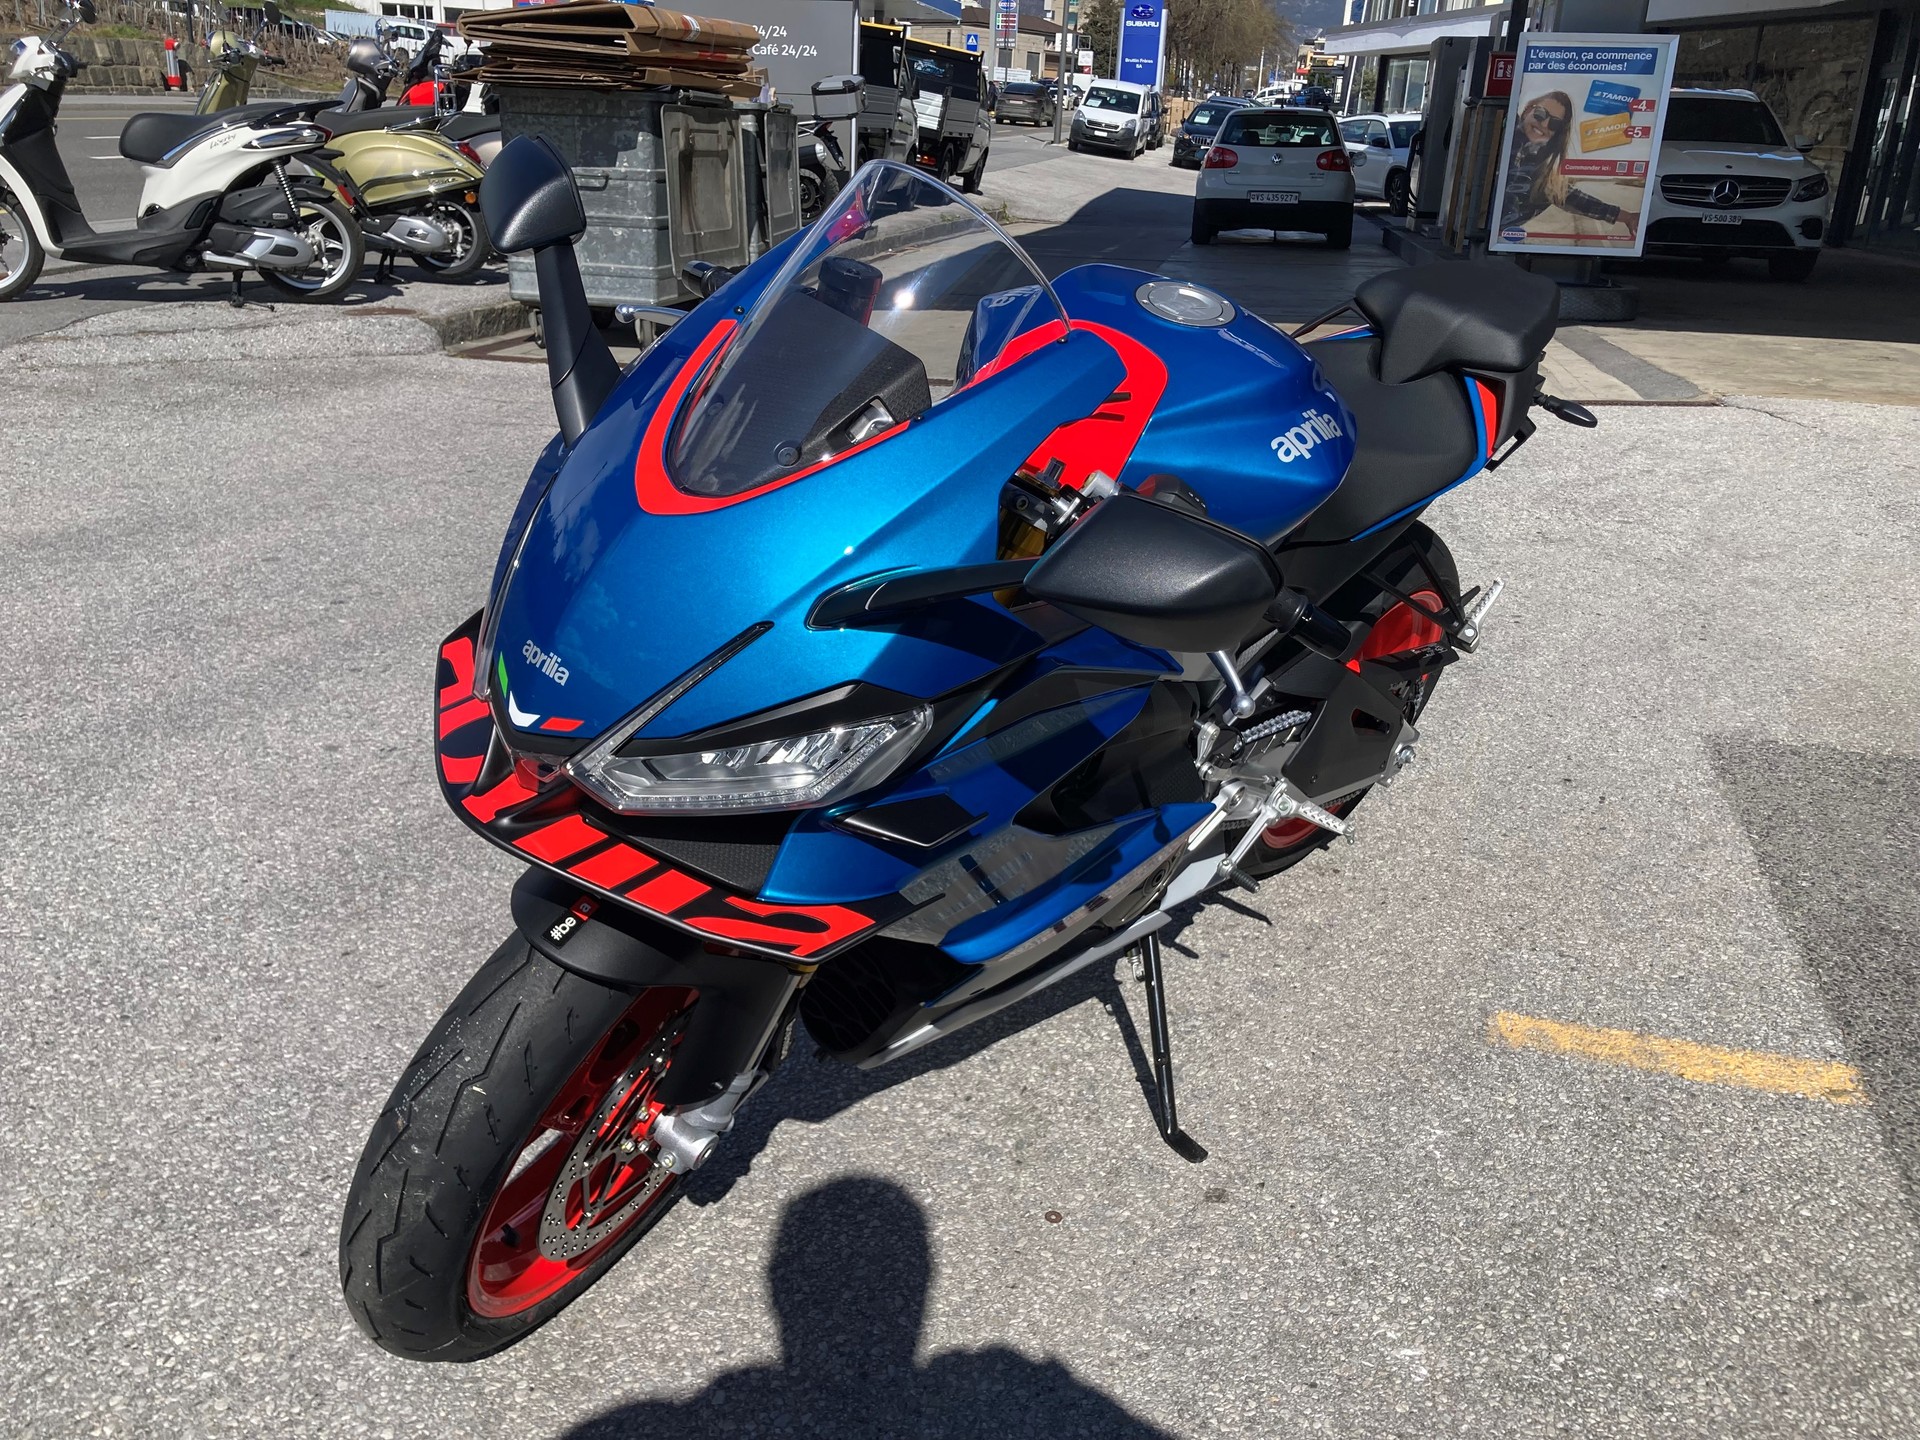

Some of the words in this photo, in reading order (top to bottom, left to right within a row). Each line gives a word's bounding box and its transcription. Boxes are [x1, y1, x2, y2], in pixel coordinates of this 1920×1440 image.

[1126, 20, 1159, 28] SUBARU
[752, 43, 779, 56] Café
[781, 44, 818, 59] 24/24
[1530, 49, 1579, 60] L'évasion,
[1581, 52, 1594, 61] ça
[1596, 52, 1653, 60] commence
[1528, 62, 1545, 71] par
[1547, 61, 1566, 70] des
[1567, 62, 1627, 71] économies!
[1256, 194, 1265, 202] VS
[1270, 408, 1343, 463] aprilia
[522, 639, 570, 687] aprilia
